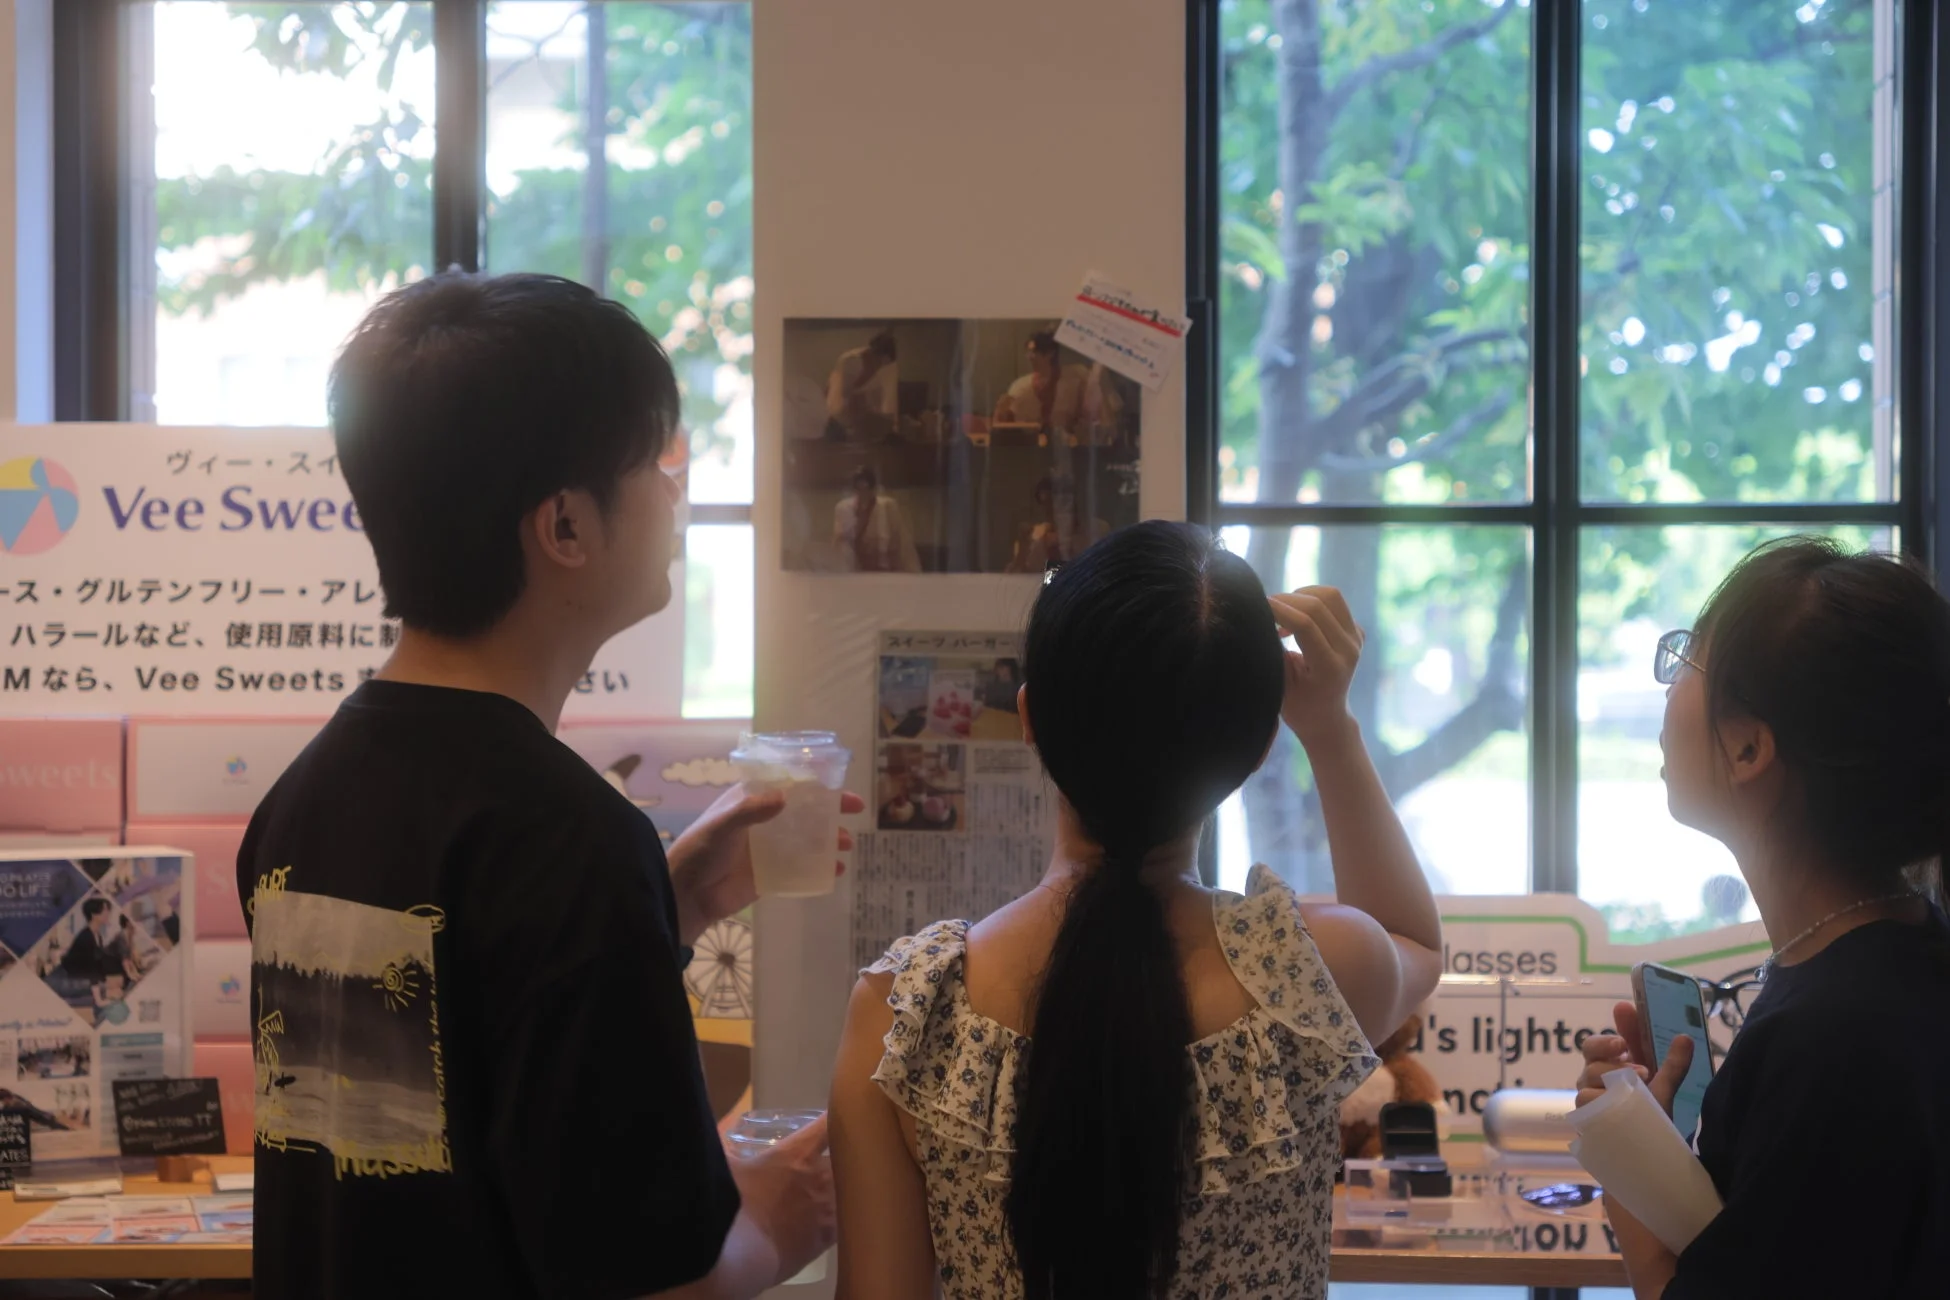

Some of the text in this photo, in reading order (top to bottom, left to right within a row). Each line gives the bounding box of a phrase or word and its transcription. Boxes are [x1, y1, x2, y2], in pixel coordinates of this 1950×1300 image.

[102, 485, 205, 532] Vee
[136, 667, 200, 691] Vee
[215, 667, 345, 692] Sweets
[0, 757, 118, 789] weets
[1444, 943, 1558, 975] lasses
[1472, 1016, 1619, 1065] lighte
